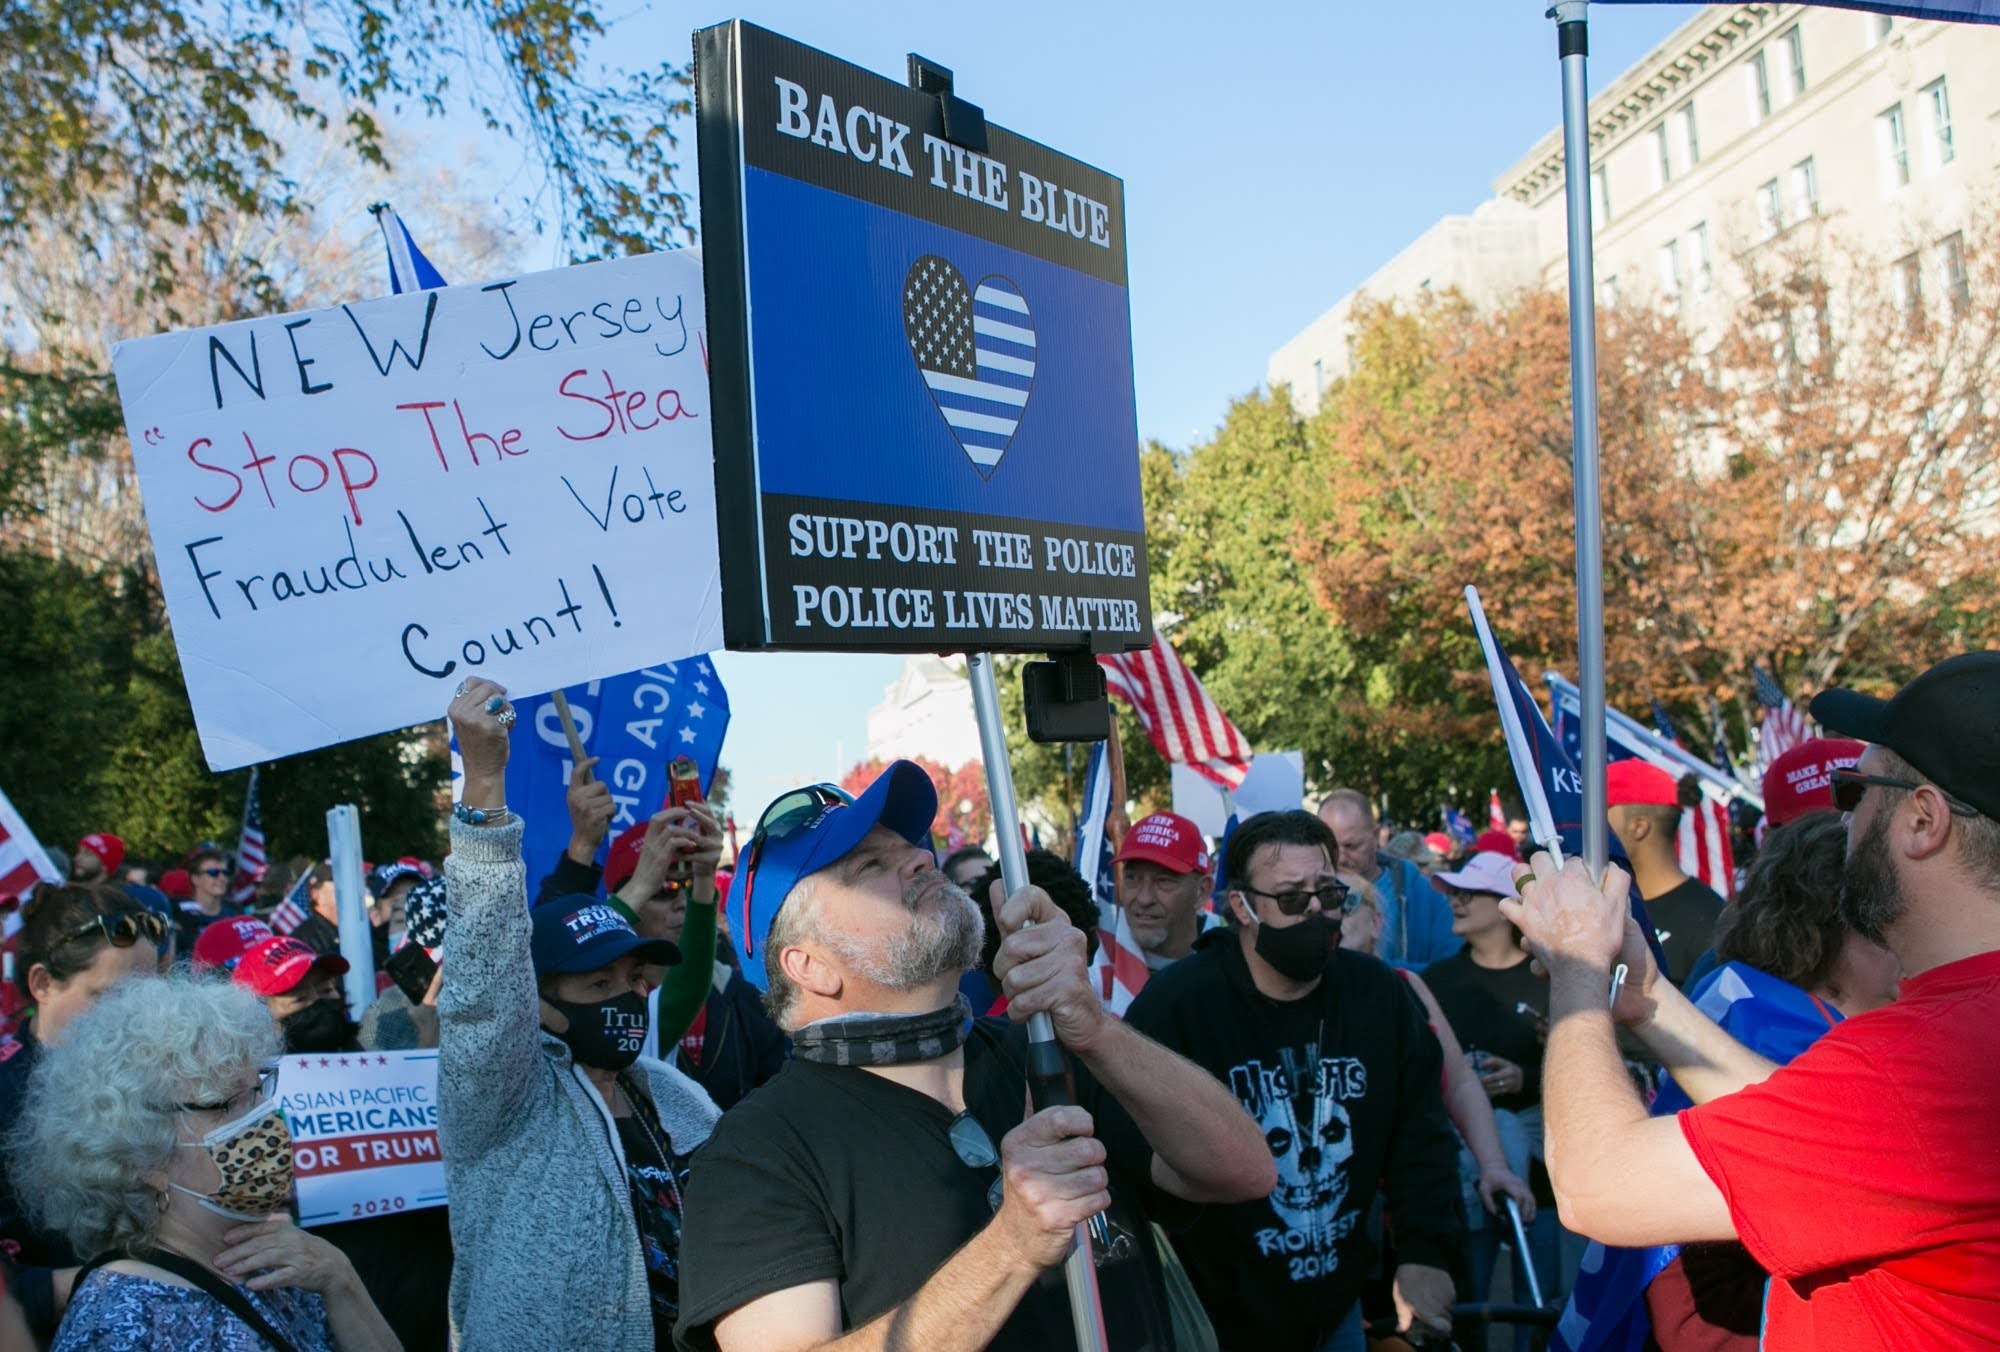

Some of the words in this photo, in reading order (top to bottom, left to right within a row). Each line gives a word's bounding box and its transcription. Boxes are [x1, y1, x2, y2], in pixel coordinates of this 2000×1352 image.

[774, 76, 914, 178] BACK
[923, 133, 1008, 211] THE
[1019, 170, 1110, 249] BLUE
[209, 292, 438, 409] NEW
[480, 280, 688, 357] Jersey
[396, 398, 529, 472] The
[185, 496, 511, 619] Fraudulent
[561, 465, 687, 531] Vote
[789, 513, 958, 565] SUPPORT
[973, 529, 1033, 570] THE
[1044, 536, 1136, 578] POLICE
[401, 564, 622, 678] Count!
[792, 584, 935, 628] POLICE
[943, 590, 1034, 631] LIVES
[1039, 595, 1141, 633] MATTER
[1551, 766, 1582, 794] KE
[1786, 764, 1820, 784] MAKE
[1824, 758, 1860, 772] AMER
[1136, 824, 1180, 841] AMERICA
[1147, 815, 1174, 828] KEEP
[1137, 834, 1173, 848] GREAT
[601, 1007, 646, 1028] Tru
[618, 1038, 641, 1051] 20
[280, 1090, 345, 1112] ASIAN
[350, 1086, 428, 1106] PACIFIC
[290, 1105, 437, 1138] MERICANS
[294, 1145, 341, 1171] OR
[351, 1136, 438, 1163] TRUM
[352, 1196, 406, 1217] 2020
[1288, 1250, 1339, 1282] 2016
